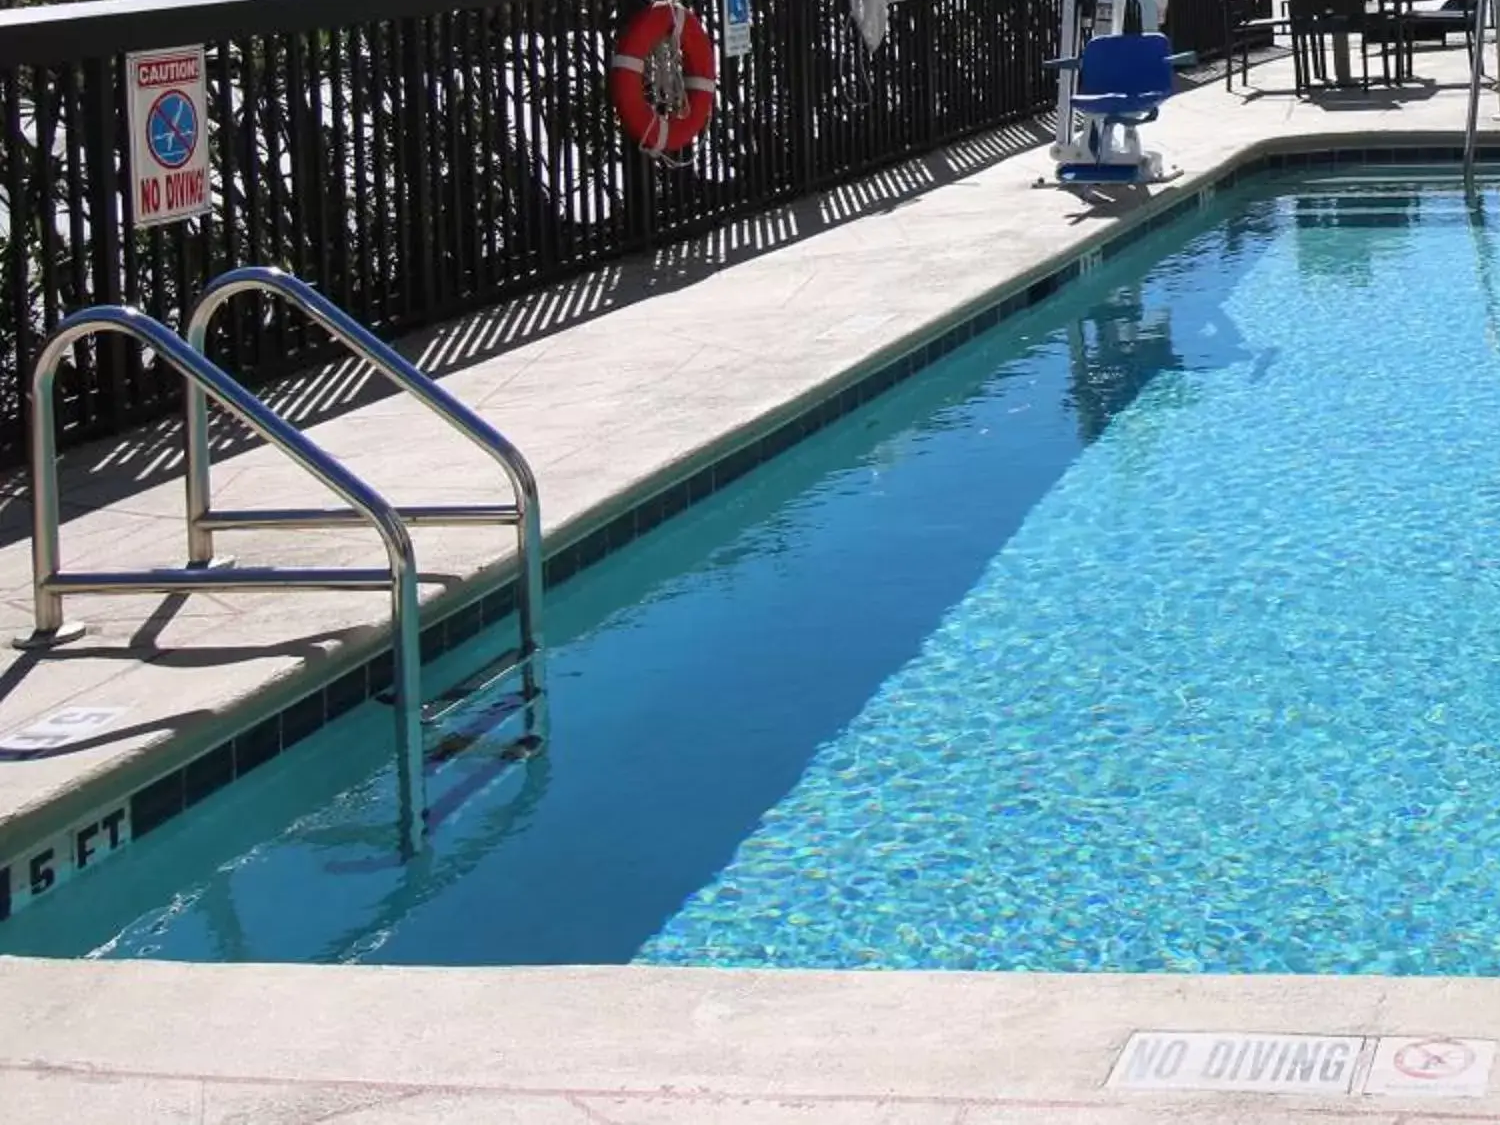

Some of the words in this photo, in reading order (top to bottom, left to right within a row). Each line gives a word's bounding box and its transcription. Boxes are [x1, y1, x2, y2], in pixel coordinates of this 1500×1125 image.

[141, 176, 161, 215] NO
[29, 848, 54, 895] 5
[77, 808, 125, 869] FT
[1124, 1038, 1188, 1079] NO
[1200, 1039, 1350, 1081] DIVING
